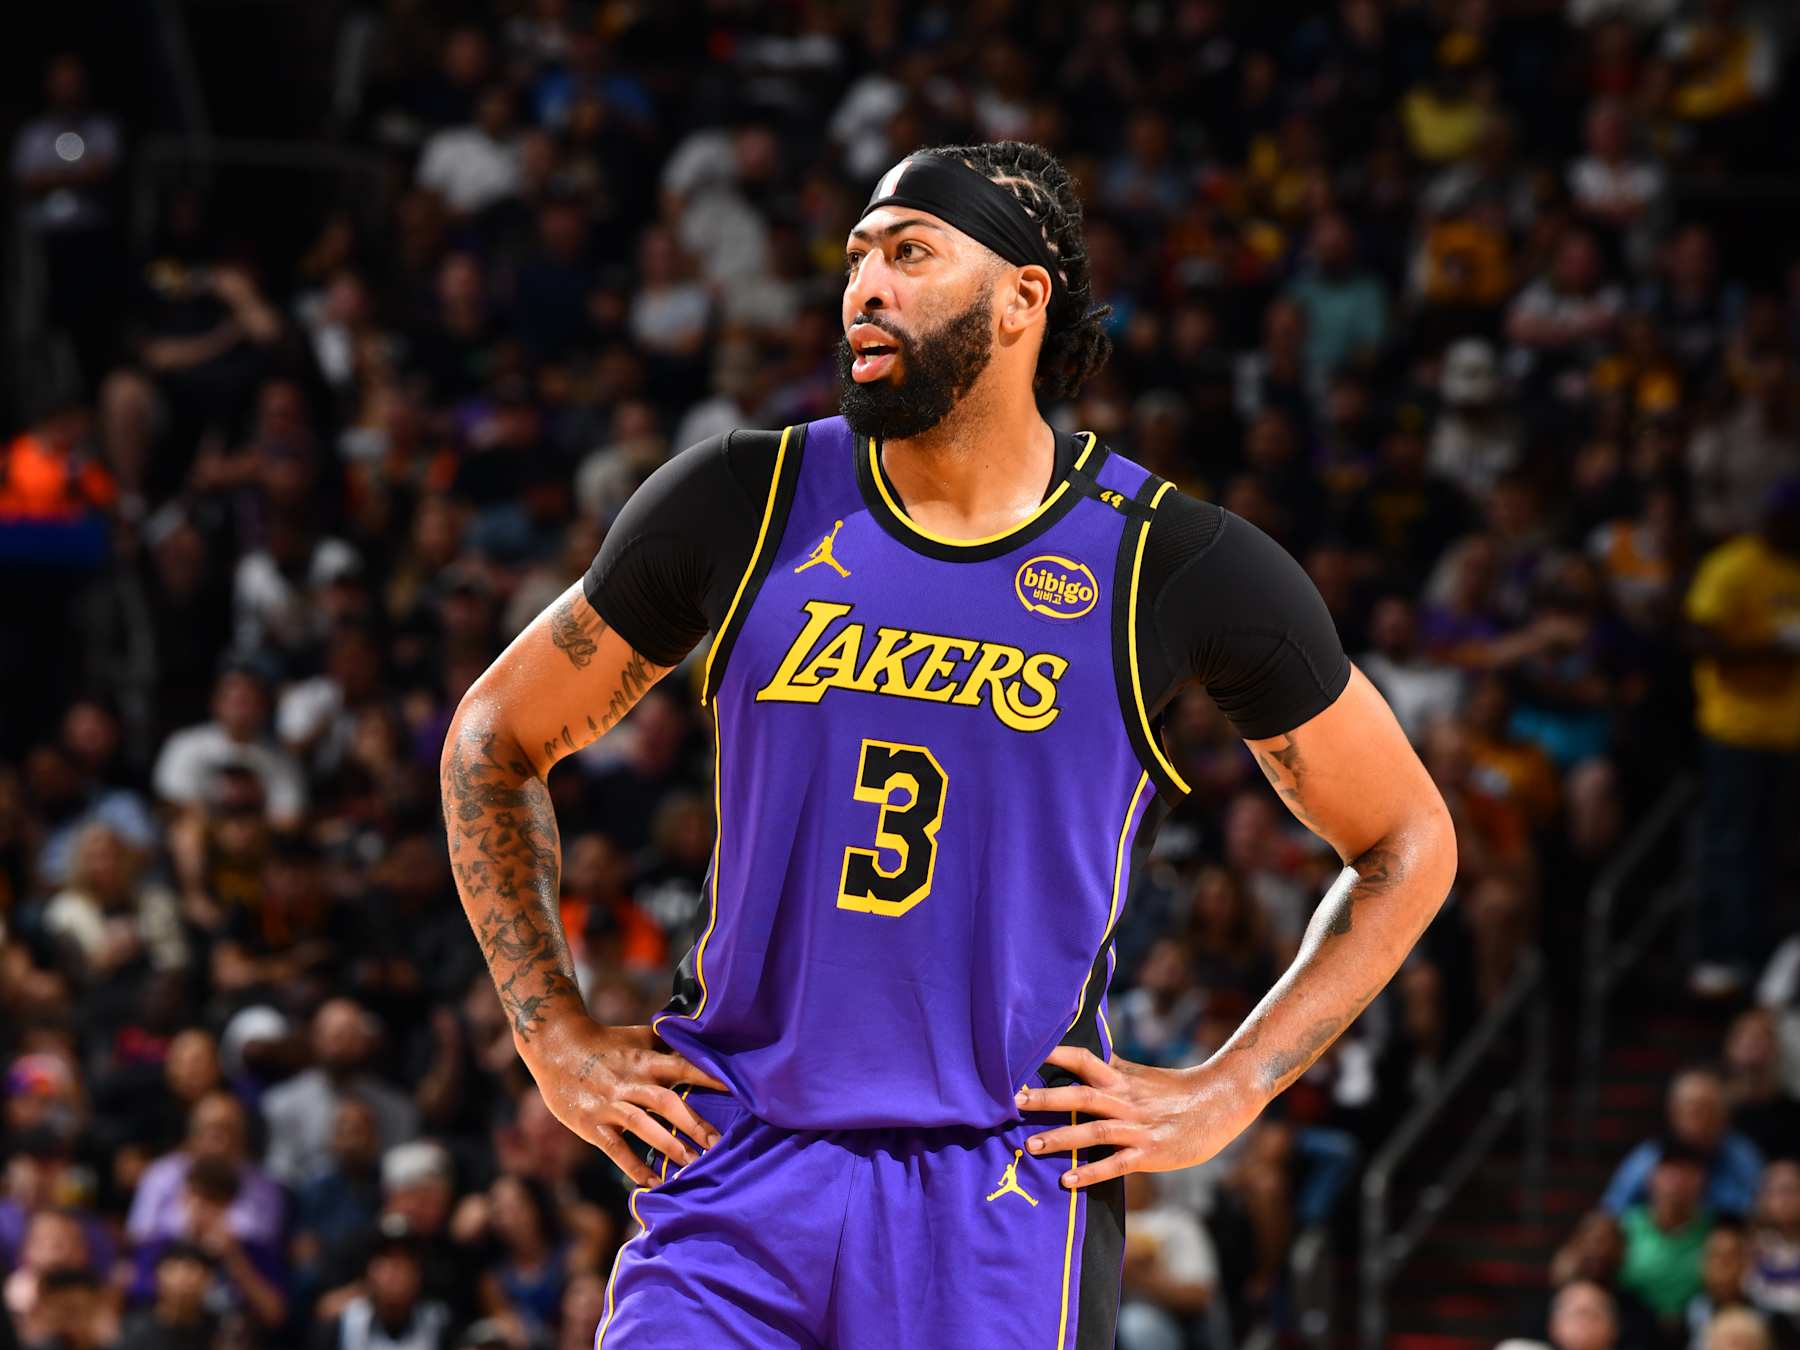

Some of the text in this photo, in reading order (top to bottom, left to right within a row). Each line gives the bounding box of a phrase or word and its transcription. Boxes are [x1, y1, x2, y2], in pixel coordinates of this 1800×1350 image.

[1100, 490, 1124, 509] 44
[1023, 567, 1094, 605] bibigo
[1032, 588, 1063, 605] 비비고
[755, 599, 1071, 733] LAKERS
[836, 738, 949, 917] 3
